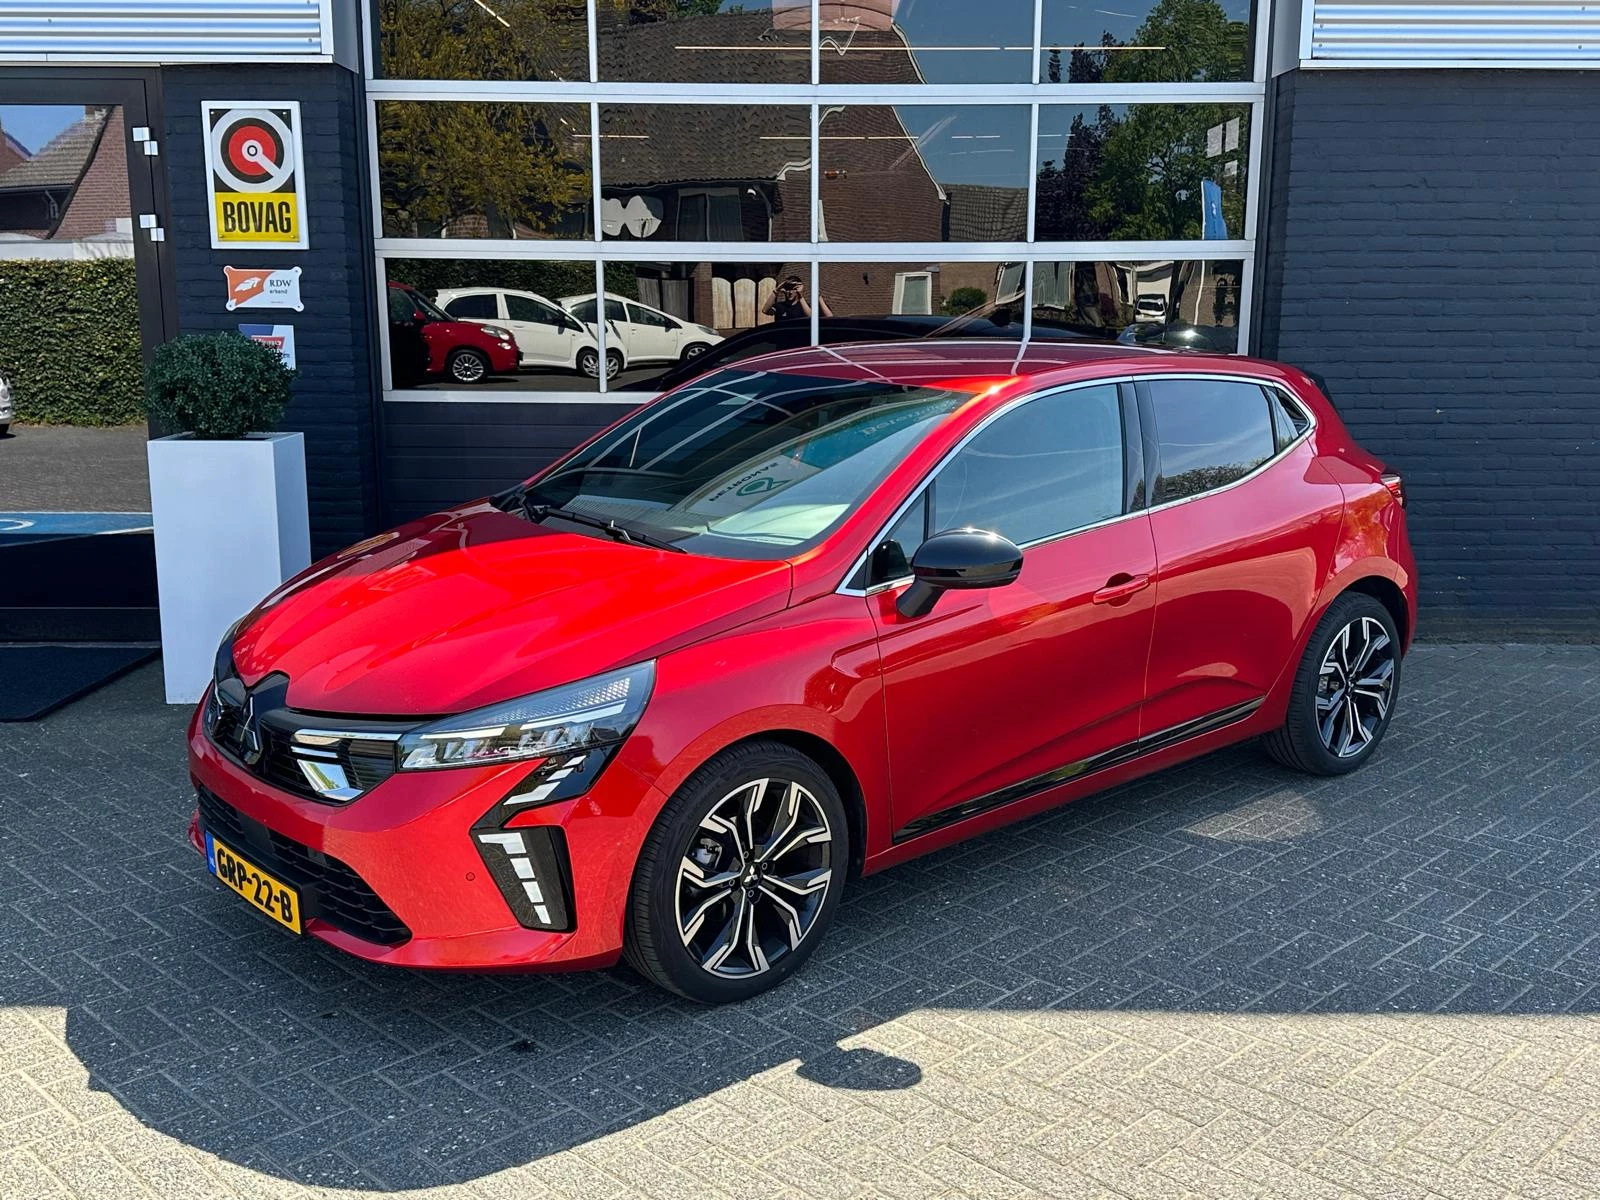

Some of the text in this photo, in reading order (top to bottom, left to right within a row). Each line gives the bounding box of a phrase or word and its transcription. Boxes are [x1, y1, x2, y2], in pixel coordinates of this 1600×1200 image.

[222, 200, 292, 234] BOVAG
[269, 279, 292, 287] RDW
[216, 847, 294, 923] GRP-22-B
